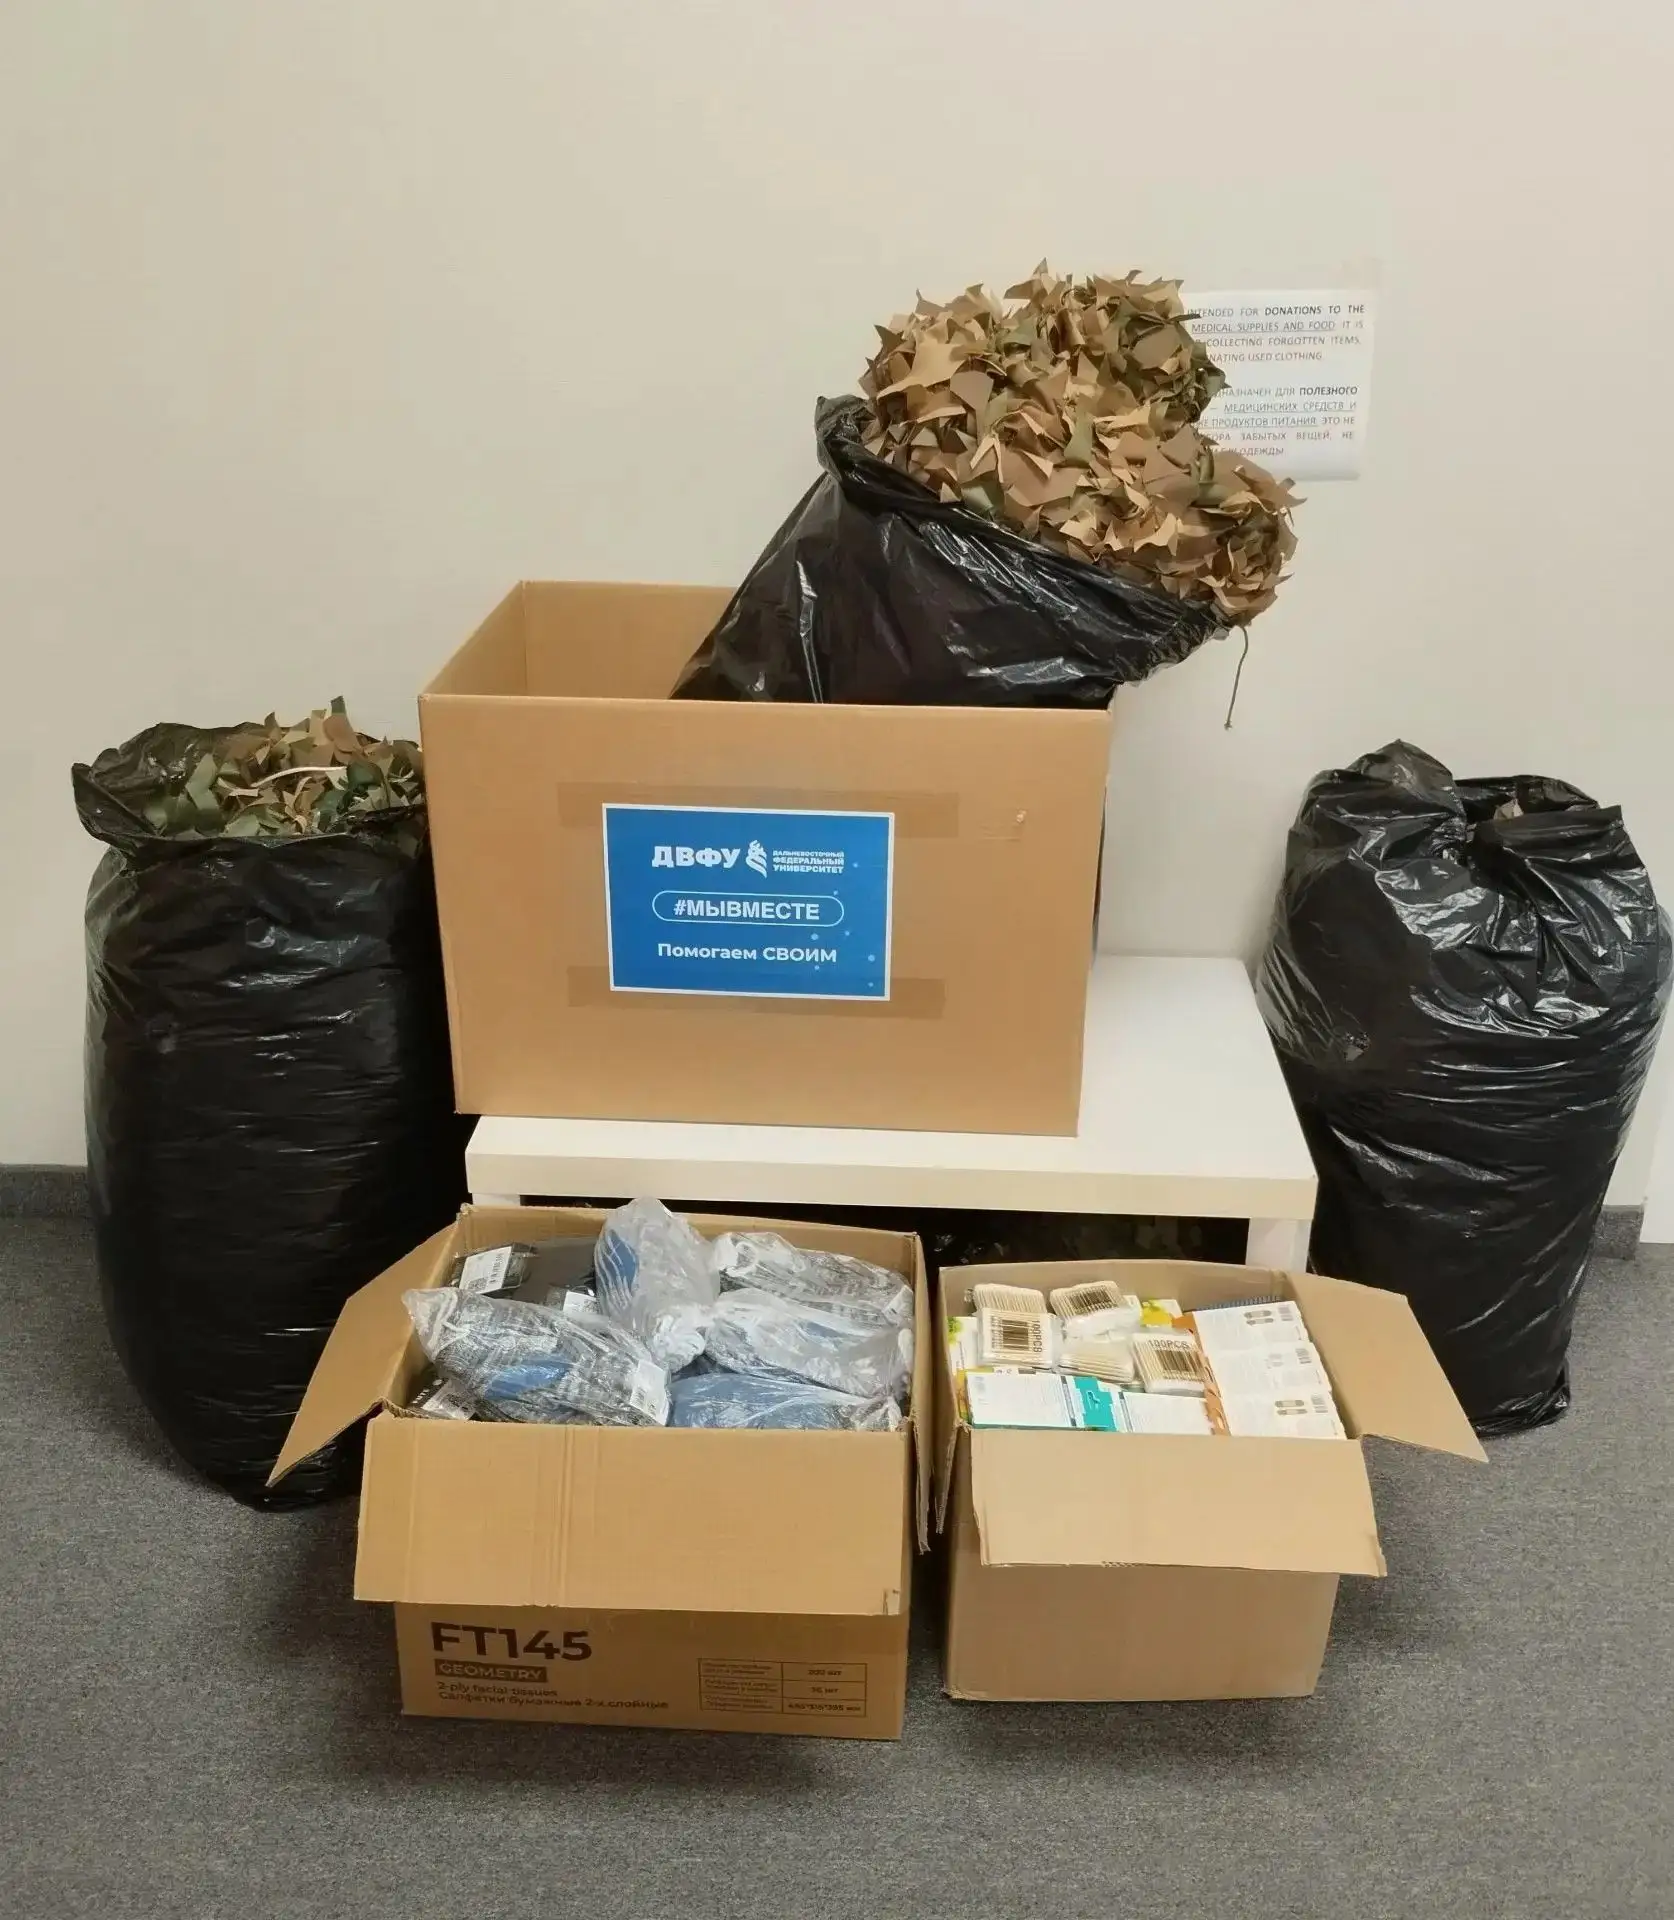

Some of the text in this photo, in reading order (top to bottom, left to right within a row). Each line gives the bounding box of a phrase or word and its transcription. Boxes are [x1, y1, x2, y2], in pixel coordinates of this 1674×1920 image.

[1240, 307, 1259, 317] FOR
[1264, 305, 1322, 317] DONATIONS
[1328, 304, 1341, 315] TO
[1347, 304, 1365, 314] THE
[1191, 322, 1233, 333] MEDICAL
[1237, 321, 1279, 332] SUPPLIES
[1283, 320, 1305, 331] AND
[1342, 319, 1351, 329] IT
[1355, 319, 1364, 329] IS
[1206, 337, 1263, 348] COLLECTING
[1268, 336, 1325, 347] FORGOTTEN
[1208, 352, 1245, 363] NATING
[1247, 352, 1272, 362] USED
[1274, 387, 1296, 398] ДЛЯ
[1299, 385, 1358, 396] ПОЛЕЗНОГО
[1224, 402, 1298, 413] МЕДИЦИНСКИХ
[1303, 401, 1345, 412] СРЕДСТВ
[1211, 416, 1269, 428] ПРОДУКТОВ
[1321, 416, 1341, 426] ЭТО
[1343, 416, 1355, 426] НЕ
[1241, 431, 1287, 442] ЗАБЫТЫХ
[1342, 430, 1354, 440] НЕ
[651, 845, 741, 869] ДВФУ
[772, 850, 845, 858] ДАЛЬНЕВОСТОЧНЫЙ
[772, 857, 845, 866] ФЕДЕРАЛЬНЫЙ
[772, 864, 845, 874] УНИВЕРСИТЕТ
[673, 899, 820, 921] #МЫВМЕСТЕ
[656, 942, 837, 963] Помогаем СВОИМ
[1031, 1319, 1043, 1354] 100PCS
[1147, 1338, 1191, 1350] 100PCS
[430, 1621, 593, 1661] FT145
[438, 1662, 542, 1681] GEOMETRY
[436, 1681, 558, 1697] 2-ply facial tissues
[438, 1692, 505, 1704] Салфетки
